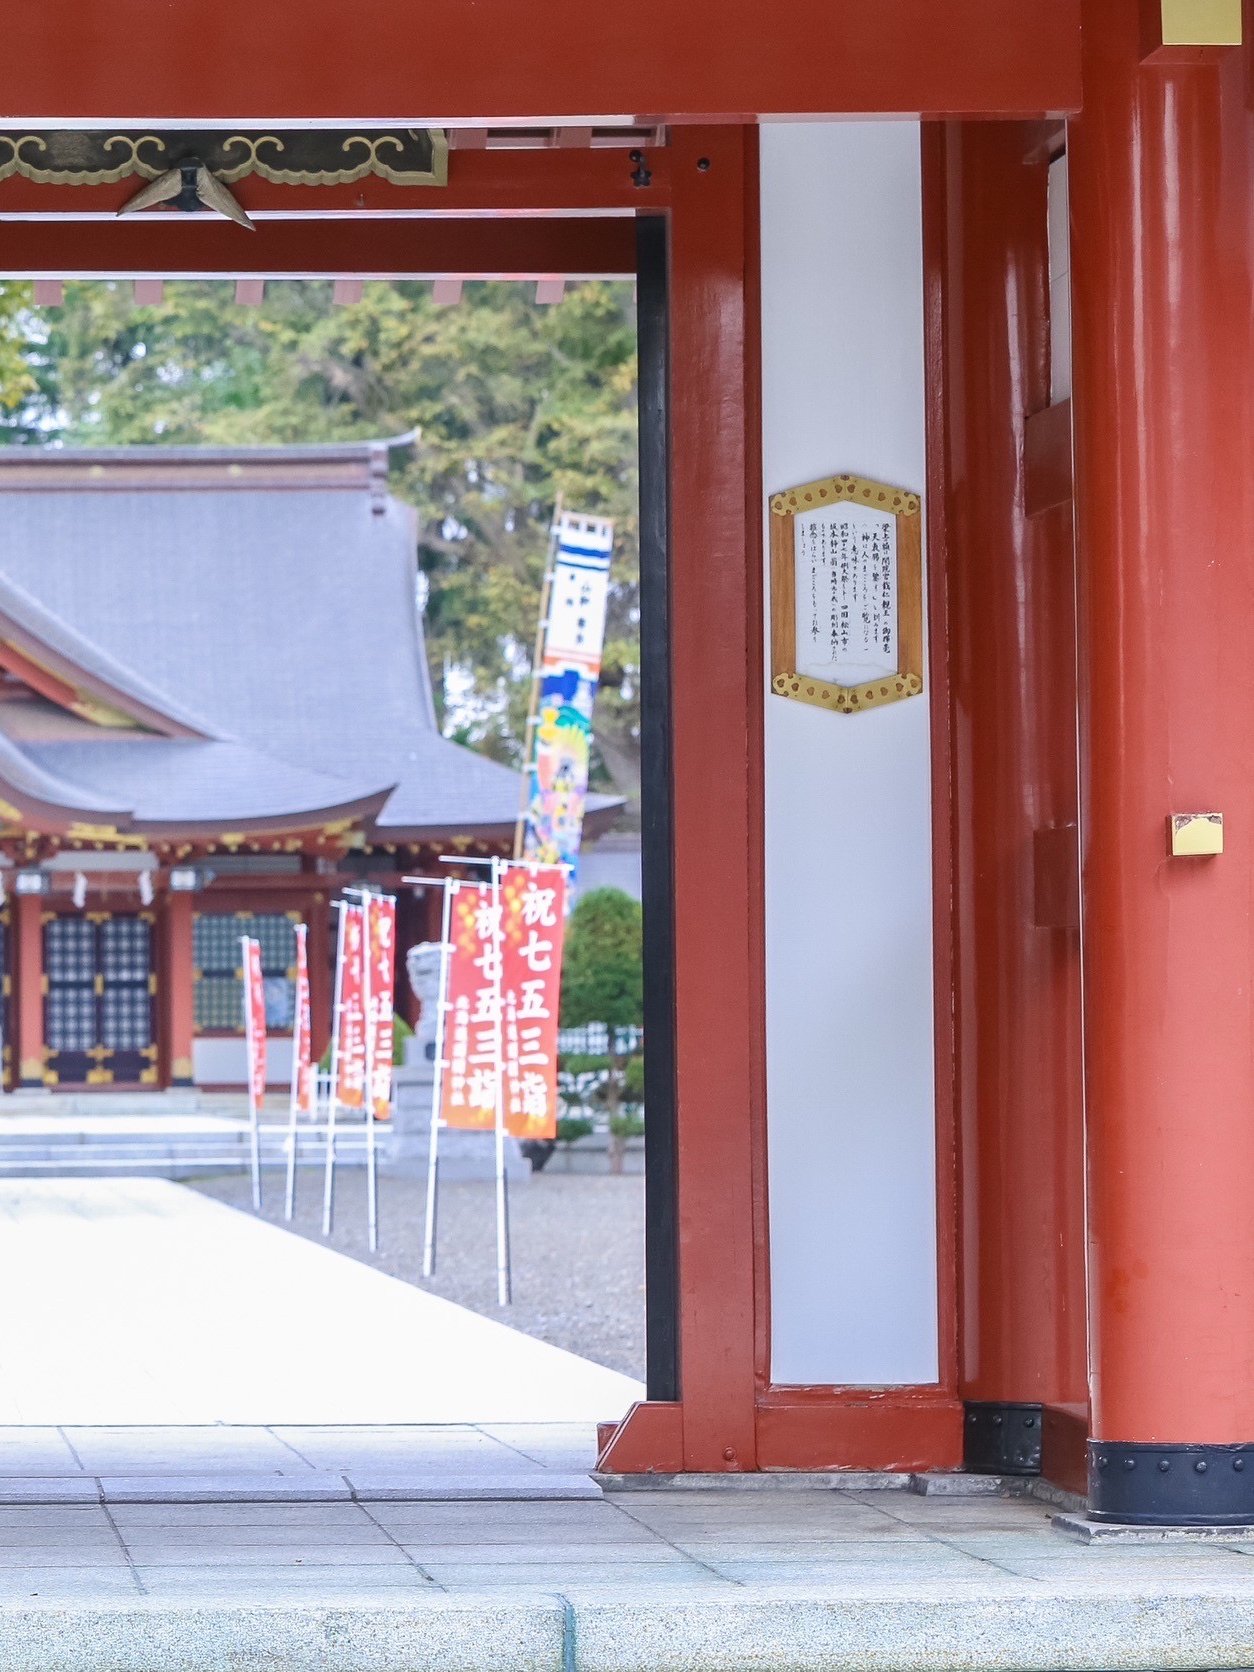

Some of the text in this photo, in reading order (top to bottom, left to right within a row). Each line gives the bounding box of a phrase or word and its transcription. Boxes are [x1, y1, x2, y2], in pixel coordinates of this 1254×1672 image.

[516, 882, 557, 1118] 祝七五三詣
